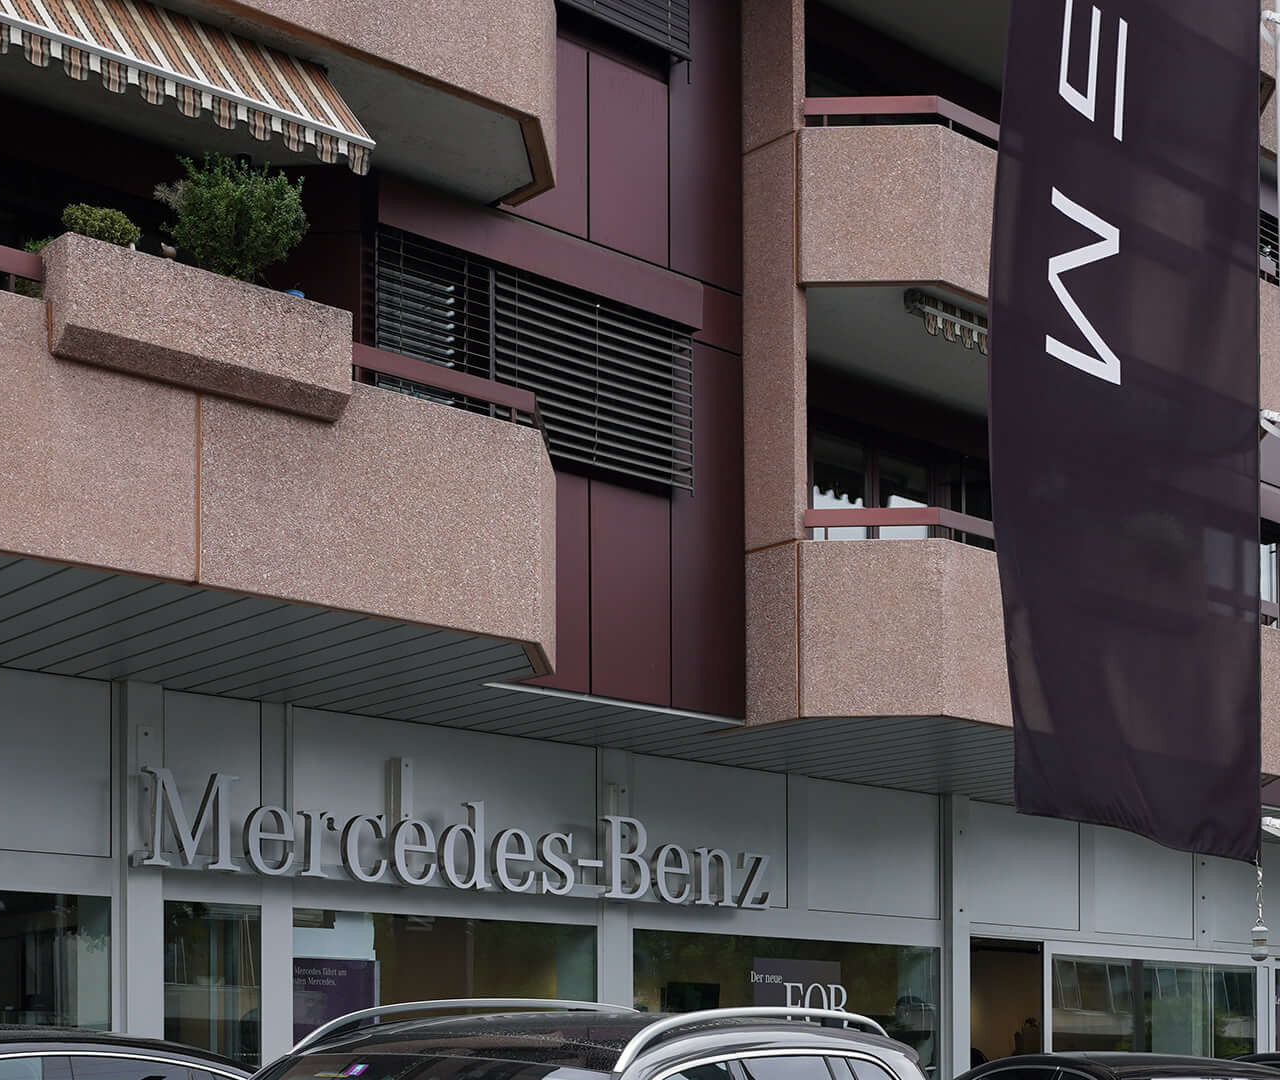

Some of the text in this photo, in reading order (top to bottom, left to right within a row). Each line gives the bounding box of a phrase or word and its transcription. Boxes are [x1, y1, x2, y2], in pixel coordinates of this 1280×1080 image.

[141, 766, 772, 910] Mercedes-Benz
[751, 970, 783, 984] Der neue
